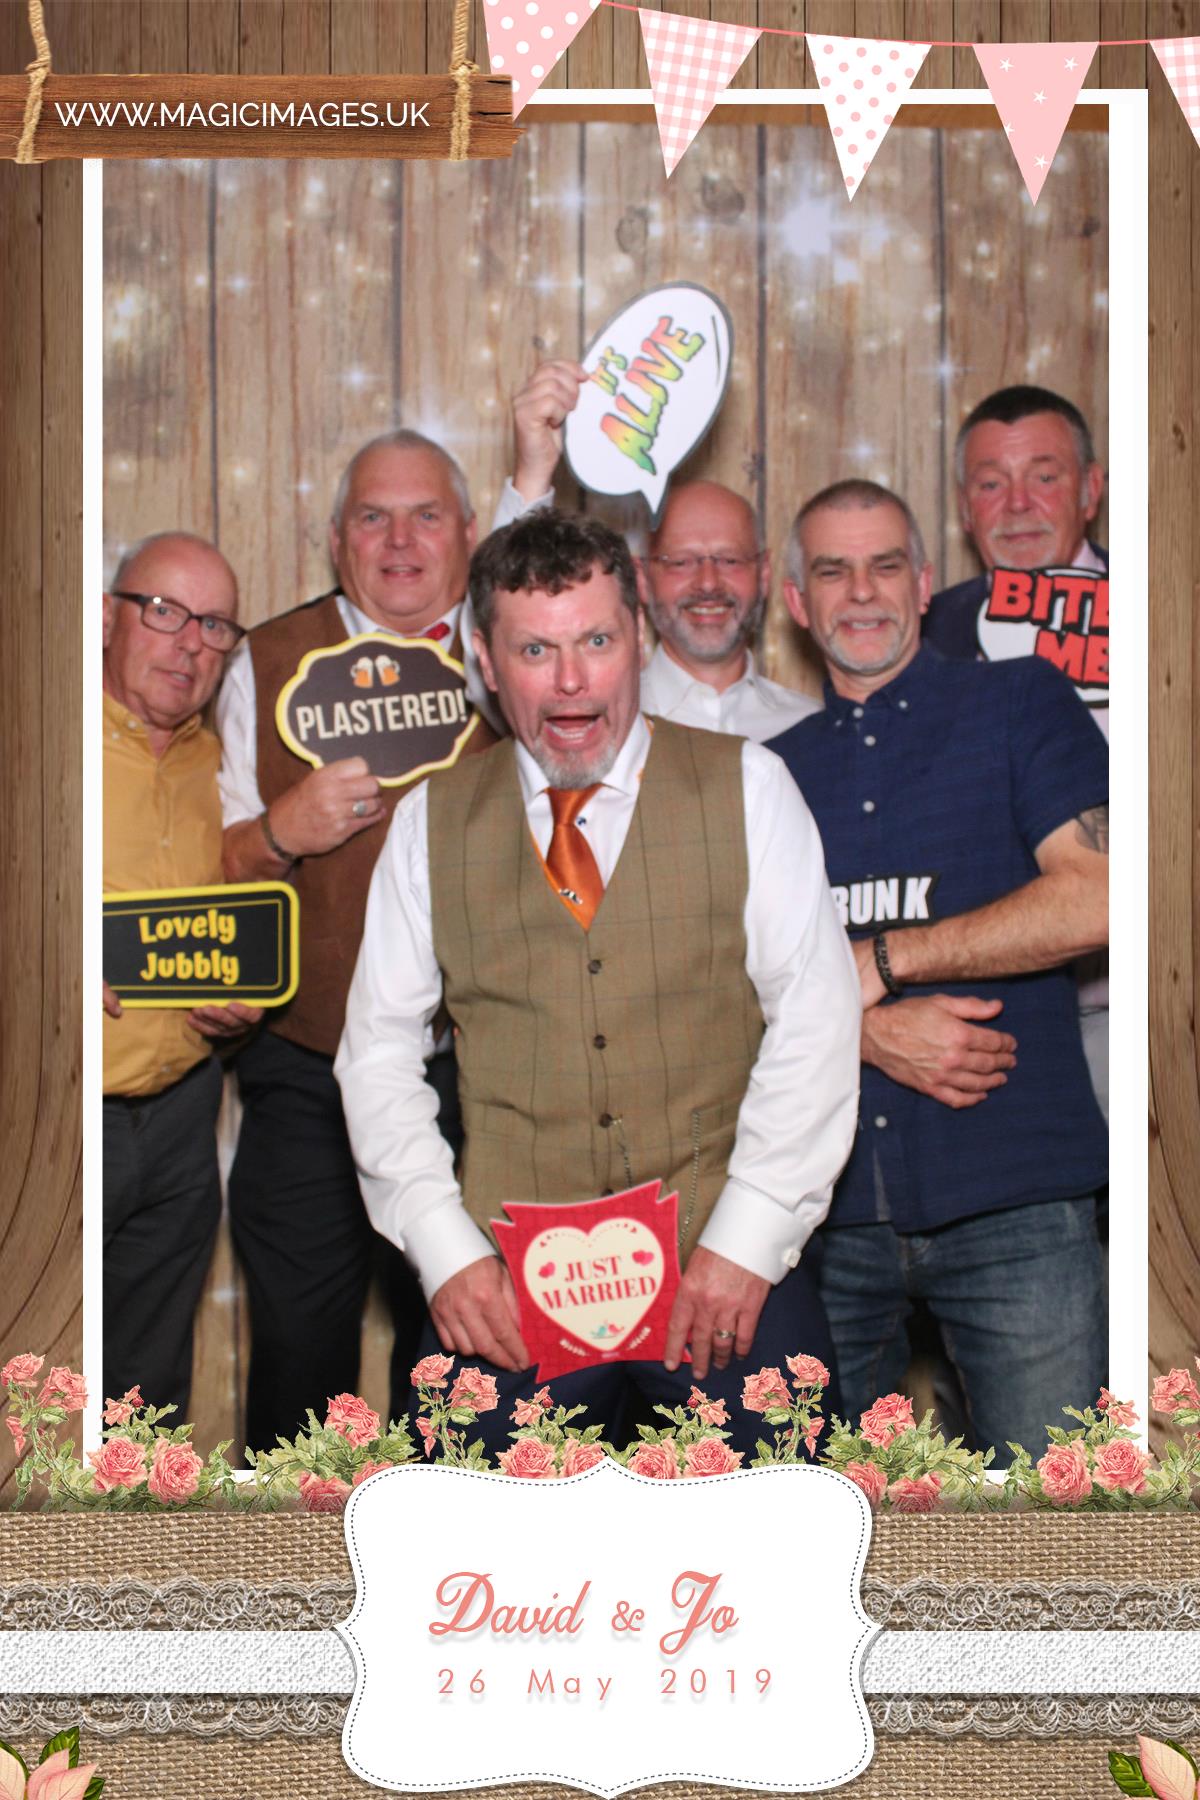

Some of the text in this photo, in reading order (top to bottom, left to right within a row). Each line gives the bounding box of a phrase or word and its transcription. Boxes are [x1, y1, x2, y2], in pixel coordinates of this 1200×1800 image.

[600, 316, 706, 476] ALIVE
[295, 688, 468, 741] PLASTERED!
[830, 876, 932, 926] RUNK
[138, 907, 237, 945] Lovely
[139, 949, 240, 985] Jubbly
[564, 1255, 621, 1283] JUST
[541, 1275, 658, 1311] MARRIED
